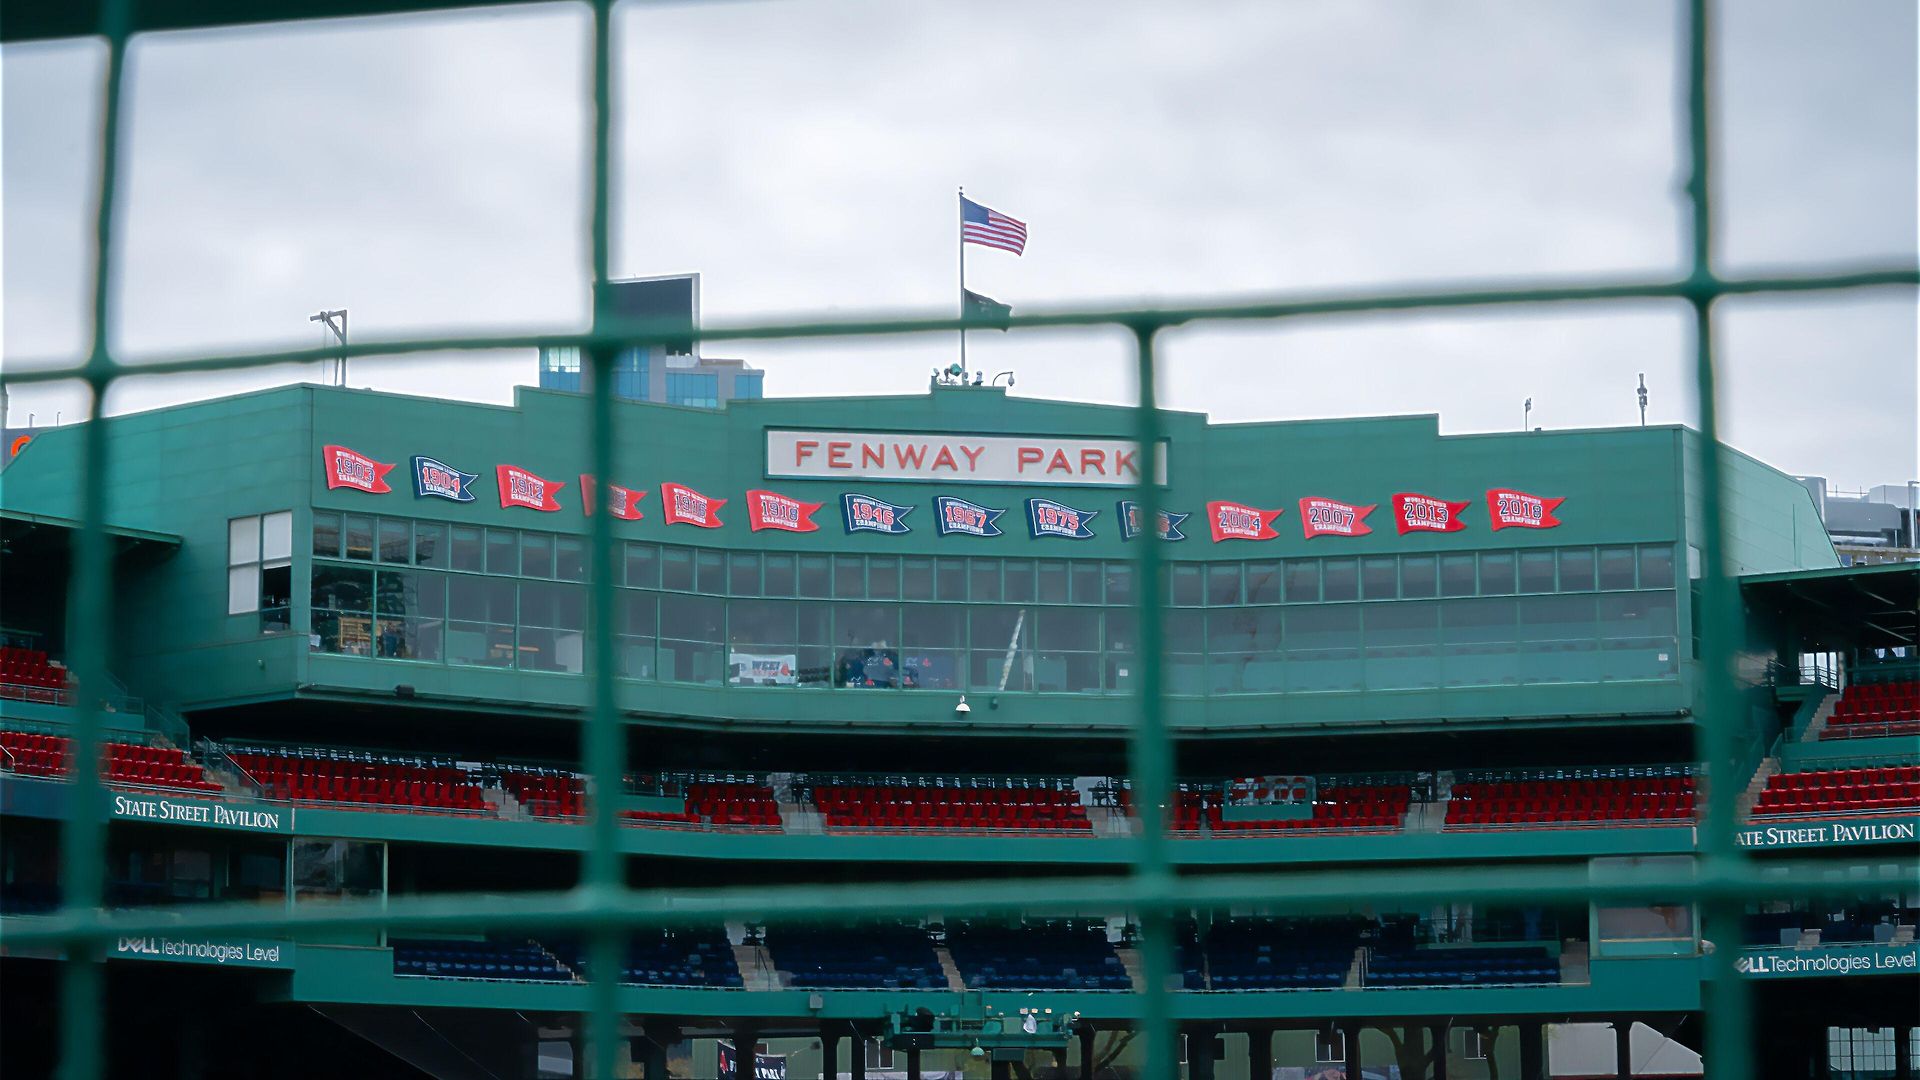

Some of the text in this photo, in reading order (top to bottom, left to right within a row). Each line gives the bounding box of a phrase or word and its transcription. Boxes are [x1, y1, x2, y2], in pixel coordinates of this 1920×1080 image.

[796, 440, 1139, 476] FENWAY PARK
[335, 458, 375, 483] 1903
[423, 467, 461, 493] 1904
[510, 476, 544, 499] 1912
[761, 500, 799, 521] 1918
[852, 503, 894, 526] 1946
[945, 505, 987, 528] 1967
[1038, 507, 1079, 530] 1975
[1218, 511, 1261, 530] 2004
[1309, 507, 1355, 528] 2007
[1403, 503, 1449, 522] 2013
[1497, 500, 1543, 519] 2018
[114, 796, 157, 818] STATE
[214, 805, 279, 828] PAVILION
[1735, 831, 1764, 846] ATE
[1832, 823, 1915, 842] PAVILION
[117, 937, 279, 962] DELL Technologies Level
[1769, 953, 1871, 974] Technologies
[1875, 951, 1916, 969] Level
